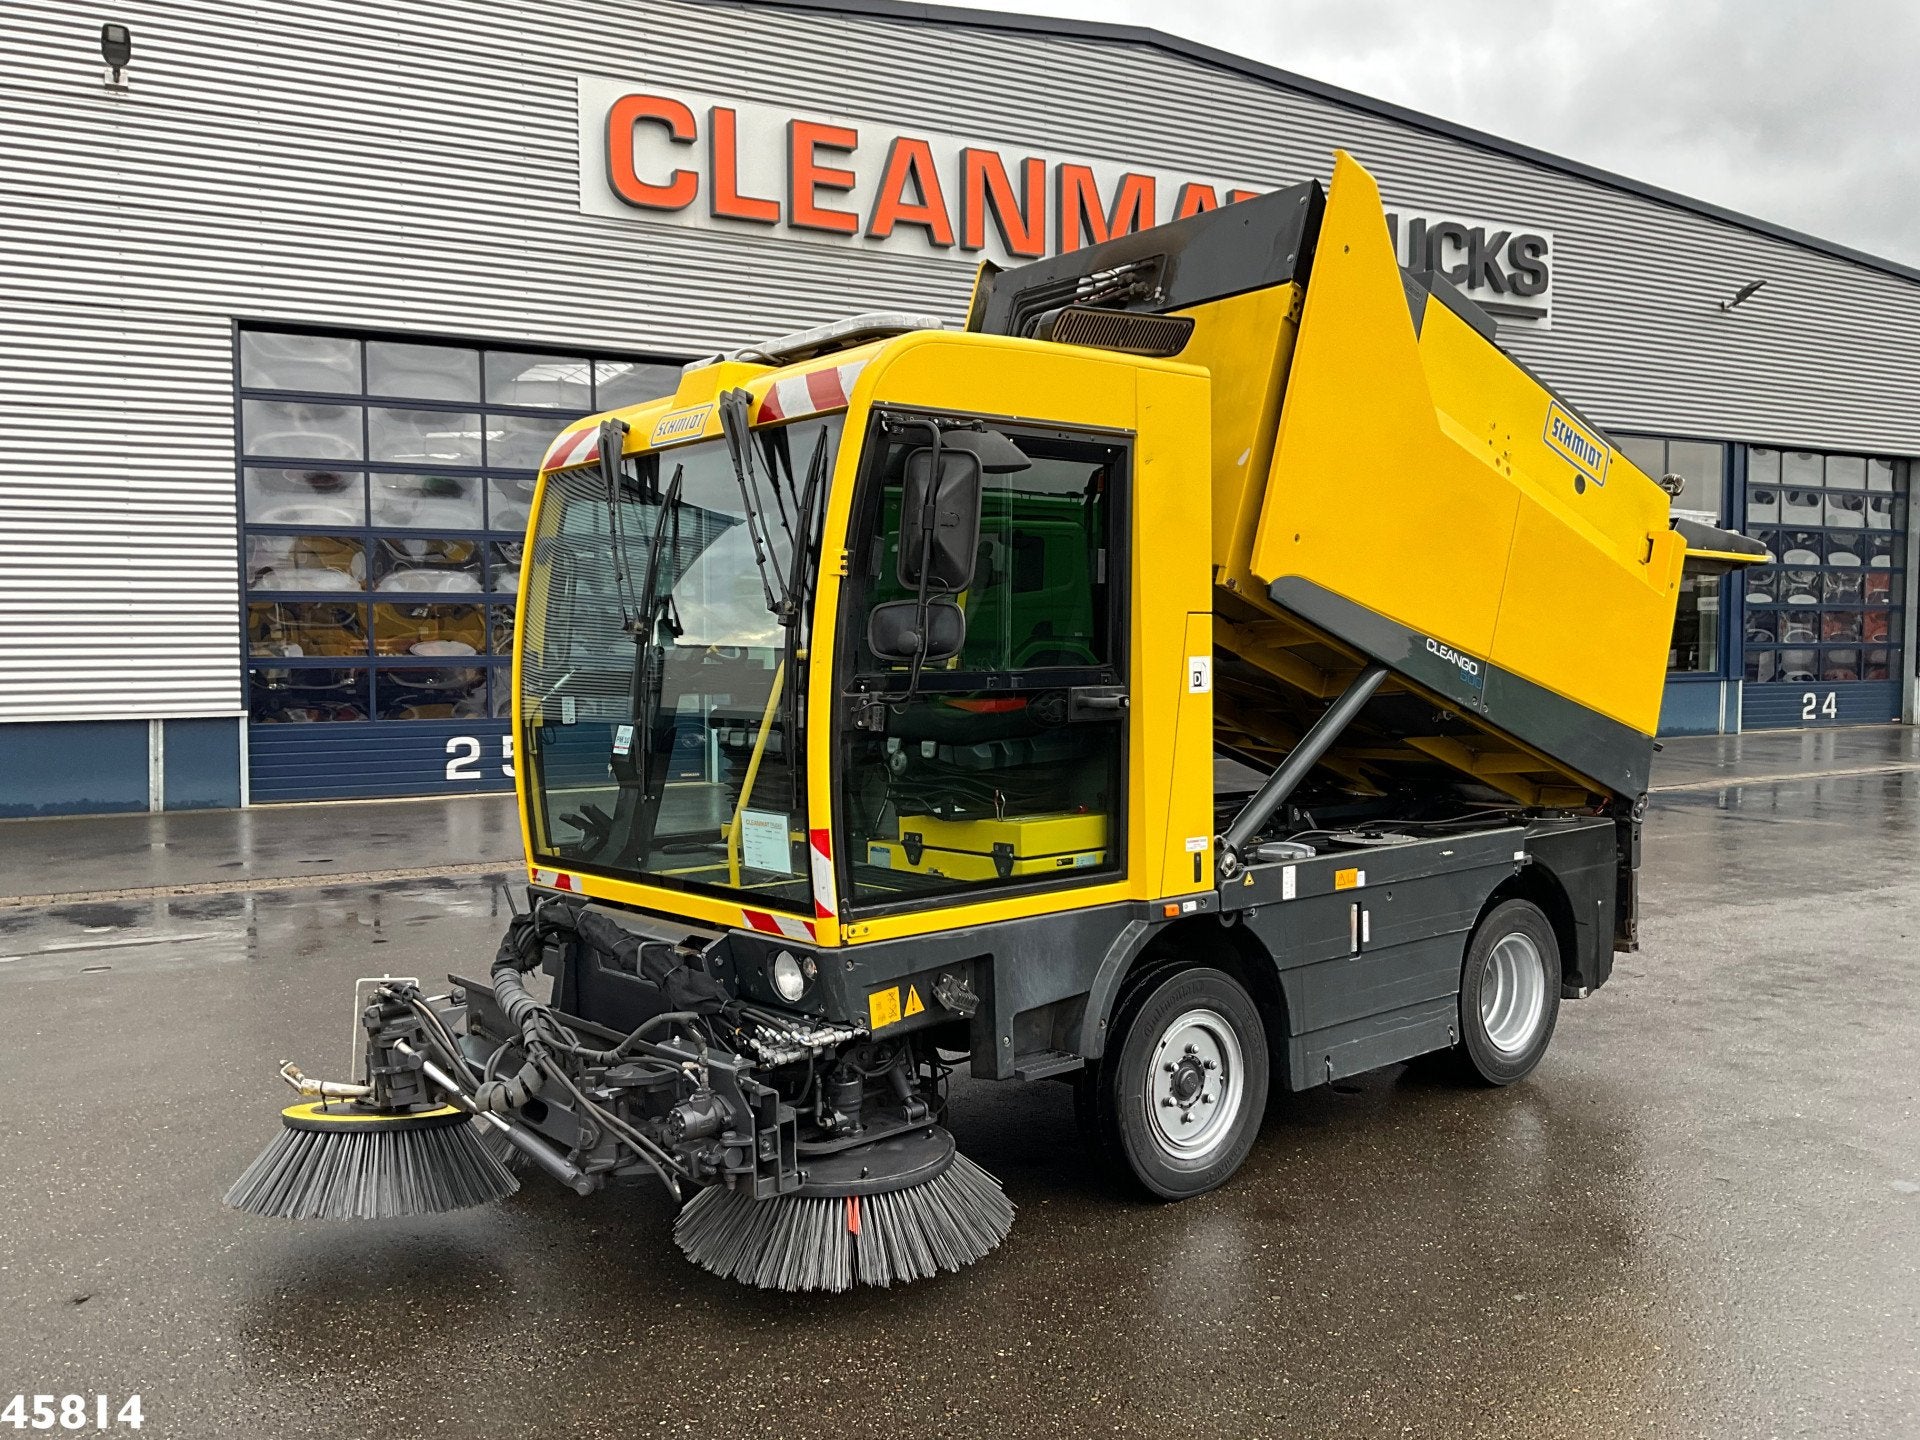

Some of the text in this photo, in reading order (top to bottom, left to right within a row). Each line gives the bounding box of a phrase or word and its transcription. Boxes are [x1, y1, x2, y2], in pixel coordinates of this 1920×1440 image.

[604, 93, 1549, 297] CLEANM UCKS
[656, 413, 705, 437] SCHMIDT
[1551, 416, 1603, 471] SCHMIDT
[1426, 637, 1478, 676] CLEANGO
[1802, 691, 1838, 720] 24
